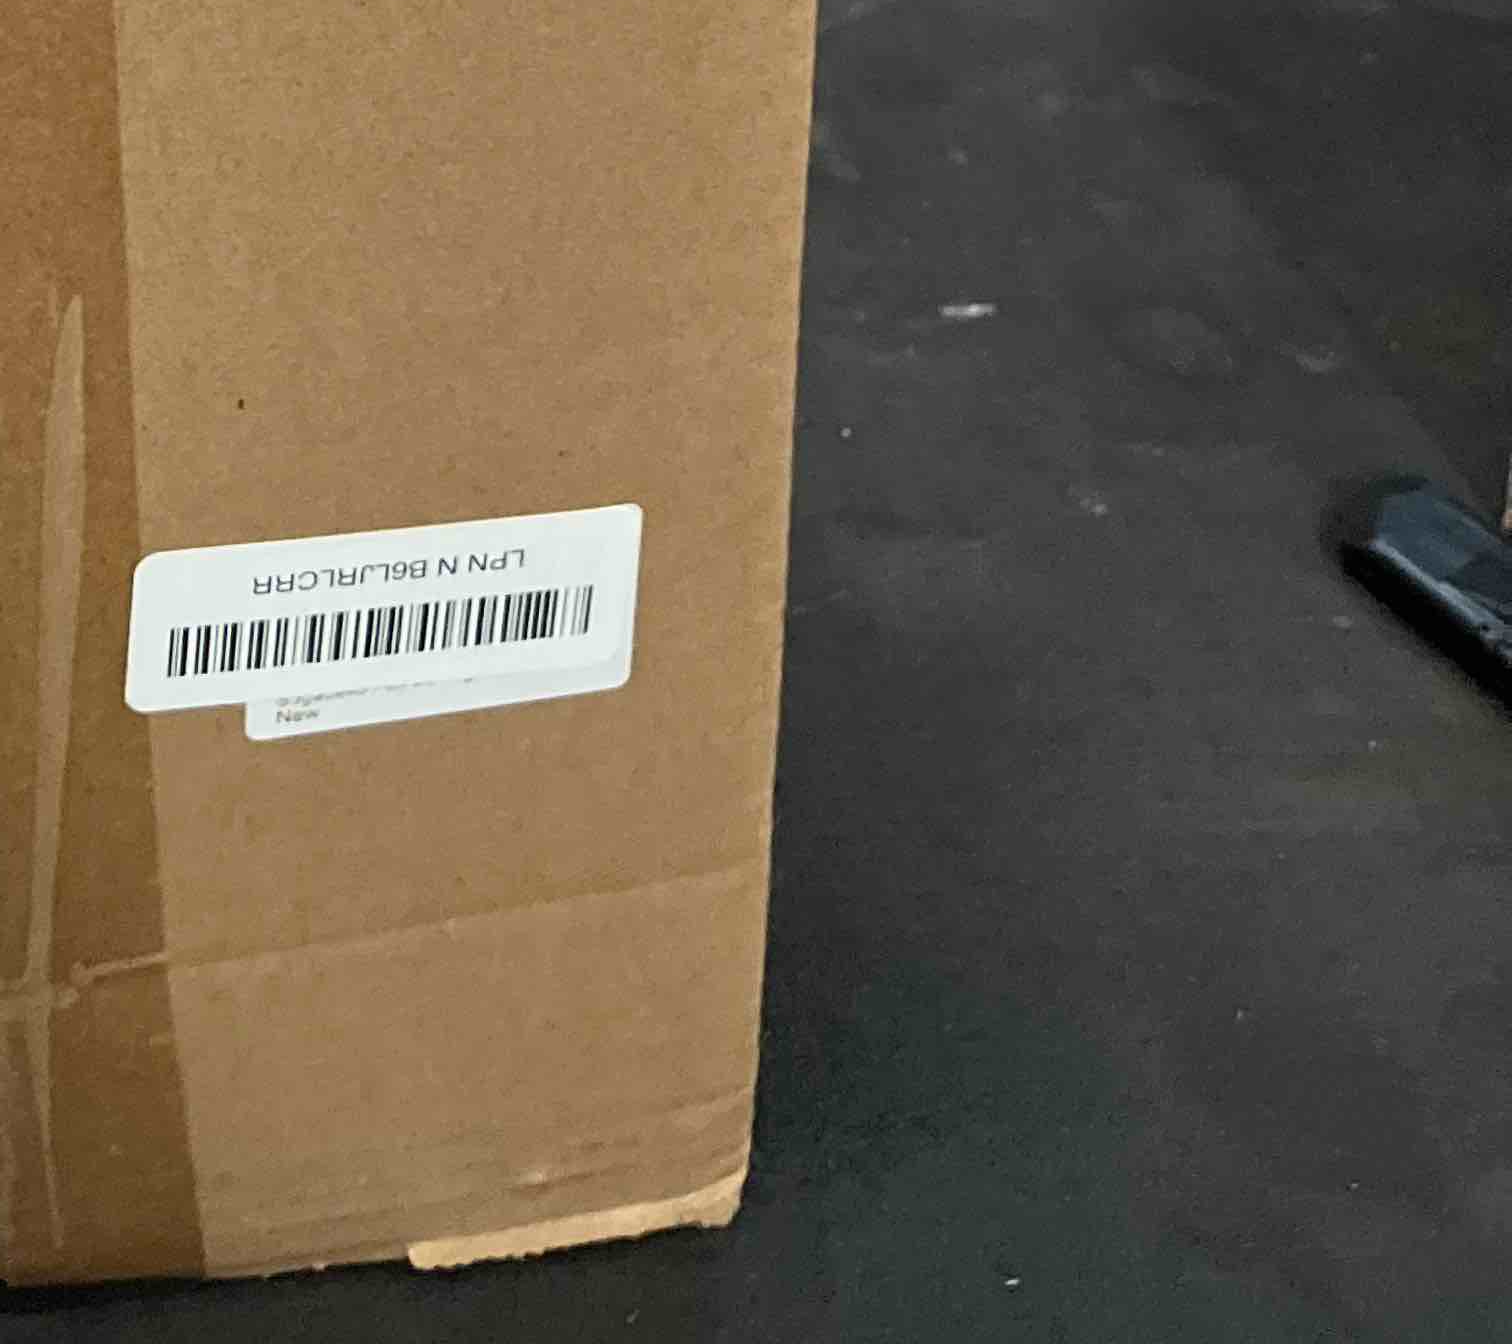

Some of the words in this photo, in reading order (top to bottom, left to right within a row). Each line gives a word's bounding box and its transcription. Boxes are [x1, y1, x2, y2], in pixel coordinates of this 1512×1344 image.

[437, 555, 459, 578] N
[468, 548, 526, 574] LPN
[275, 709, 320, 724] New
